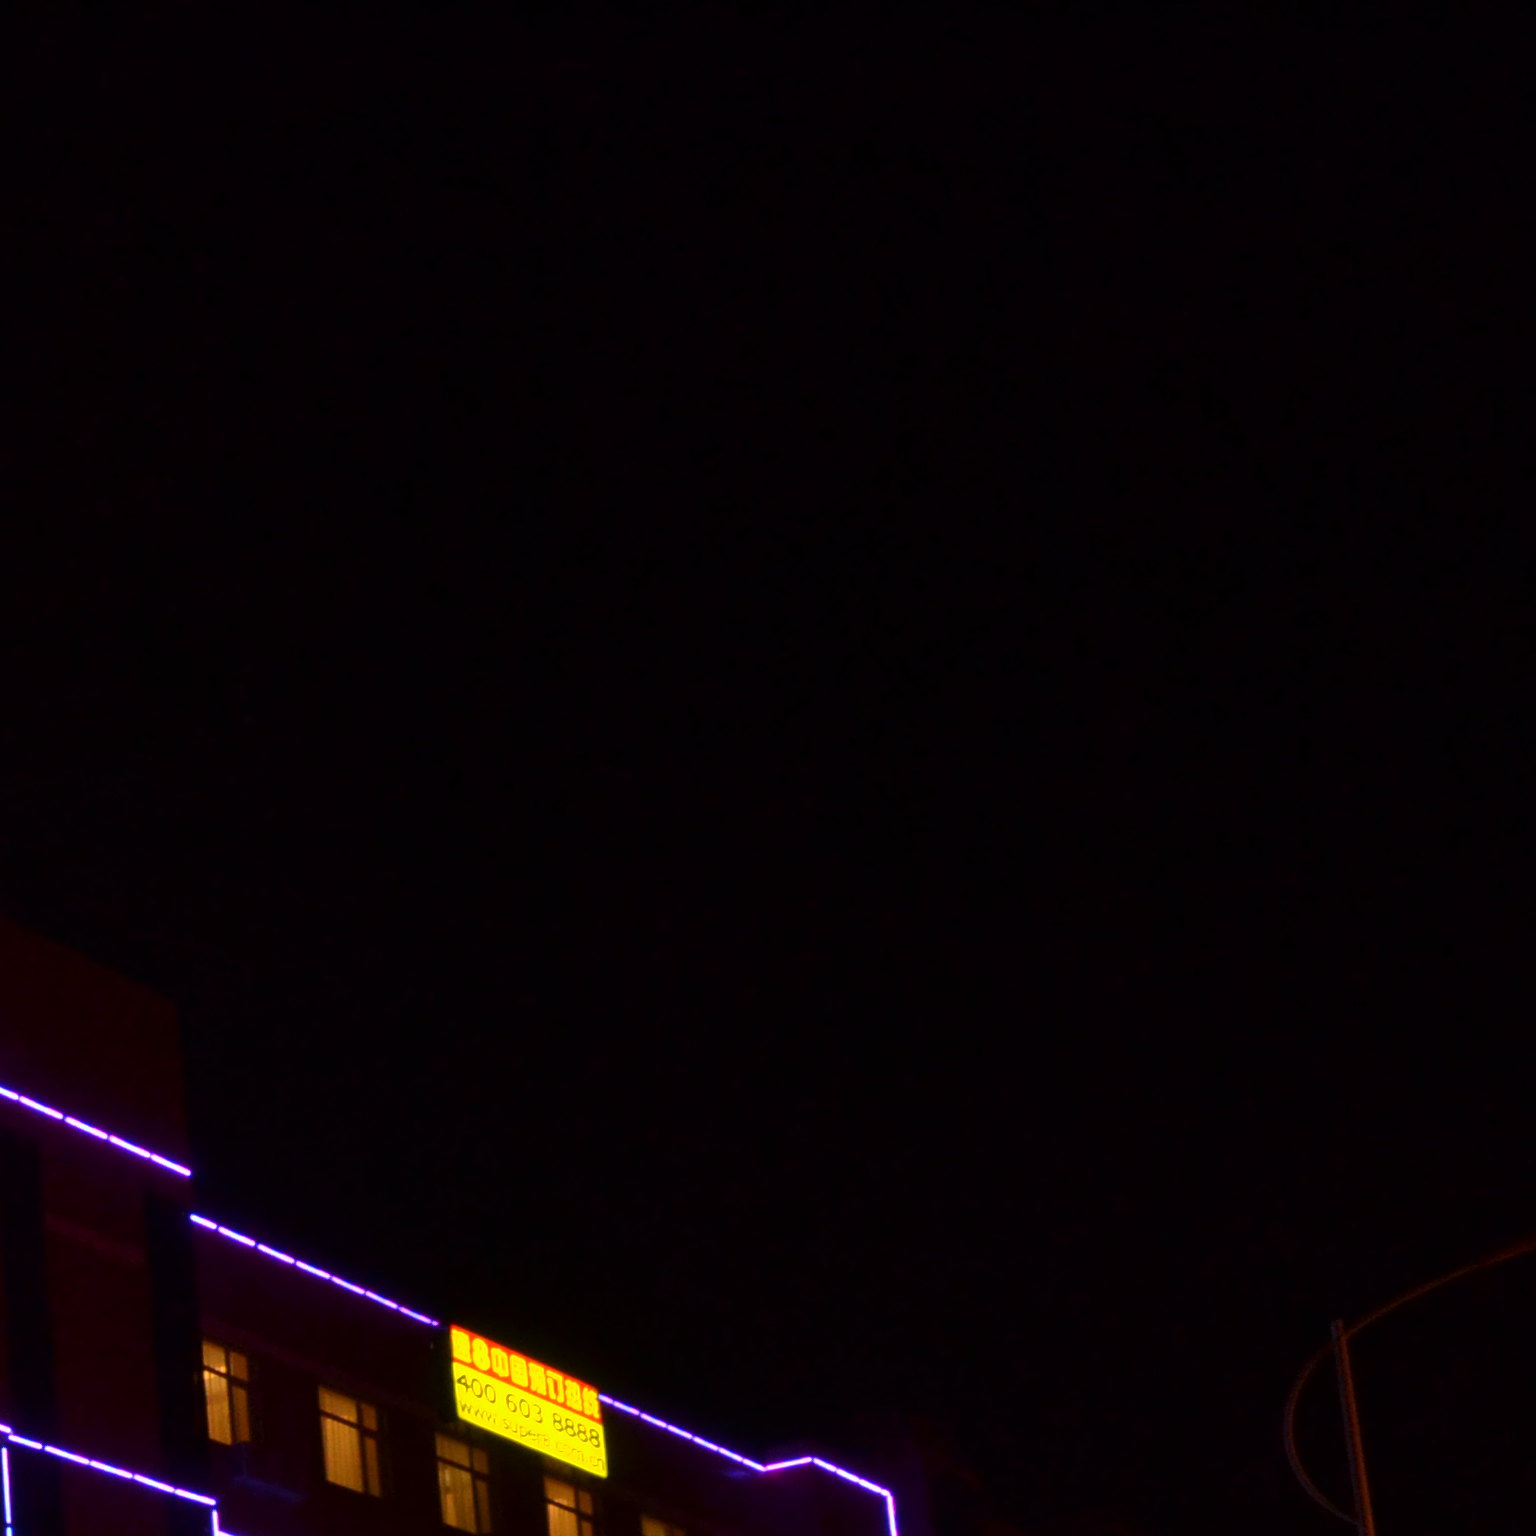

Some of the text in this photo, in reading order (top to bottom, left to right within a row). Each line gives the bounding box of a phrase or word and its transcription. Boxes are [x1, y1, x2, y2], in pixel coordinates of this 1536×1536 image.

[456, 1374, 601, 1448] 400 603 8888
